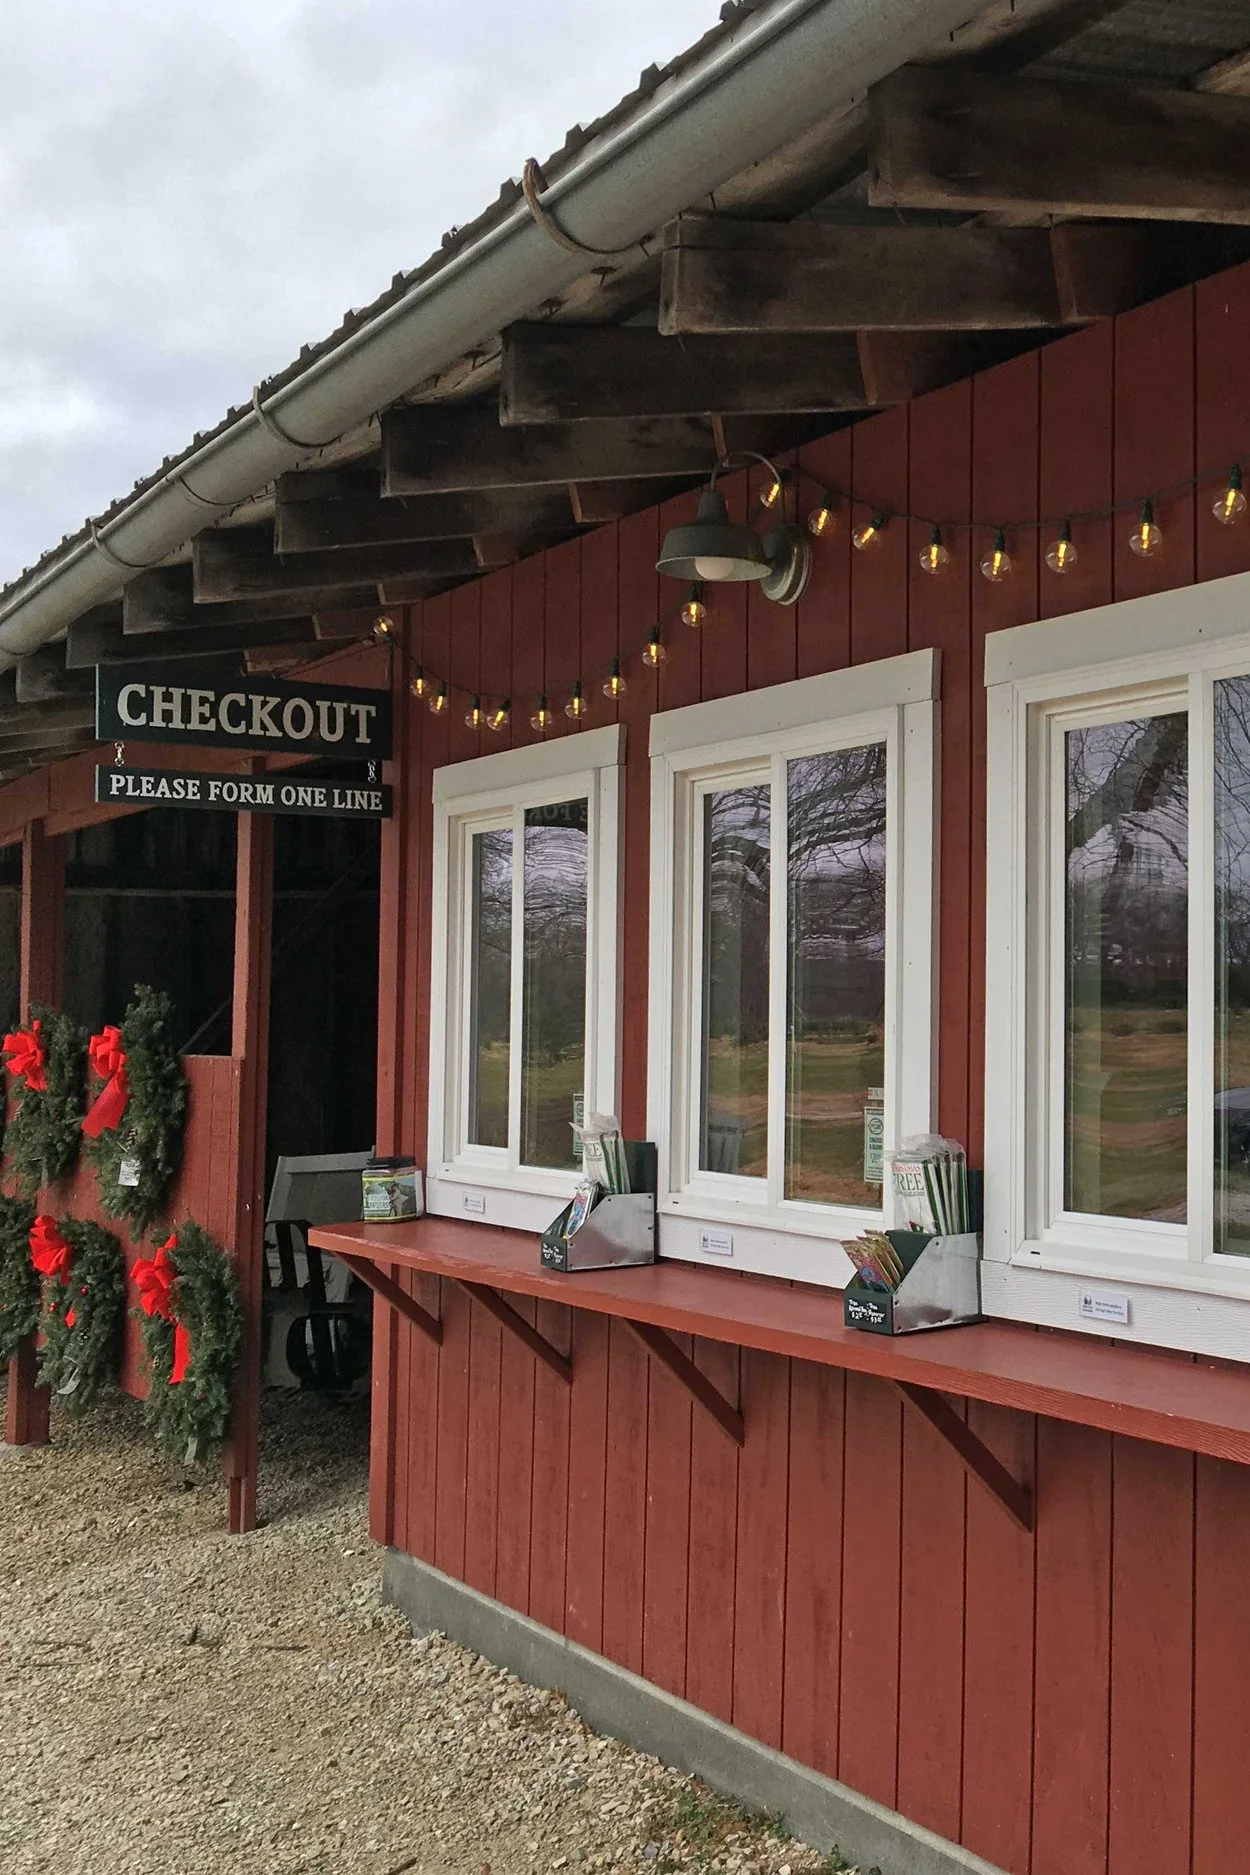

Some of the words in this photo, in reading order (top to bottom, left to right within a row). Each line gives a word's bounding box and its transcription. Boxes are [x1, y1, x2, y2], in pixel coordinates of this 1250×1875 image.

[116, 683, 376, 745] CHECKOUT
[110, 774, 200, 799] PLEASE
[208, 781, 275, 805] FORM
[280, 785, 327, 808] ONE
[332, 789, 383, 811] LINE
